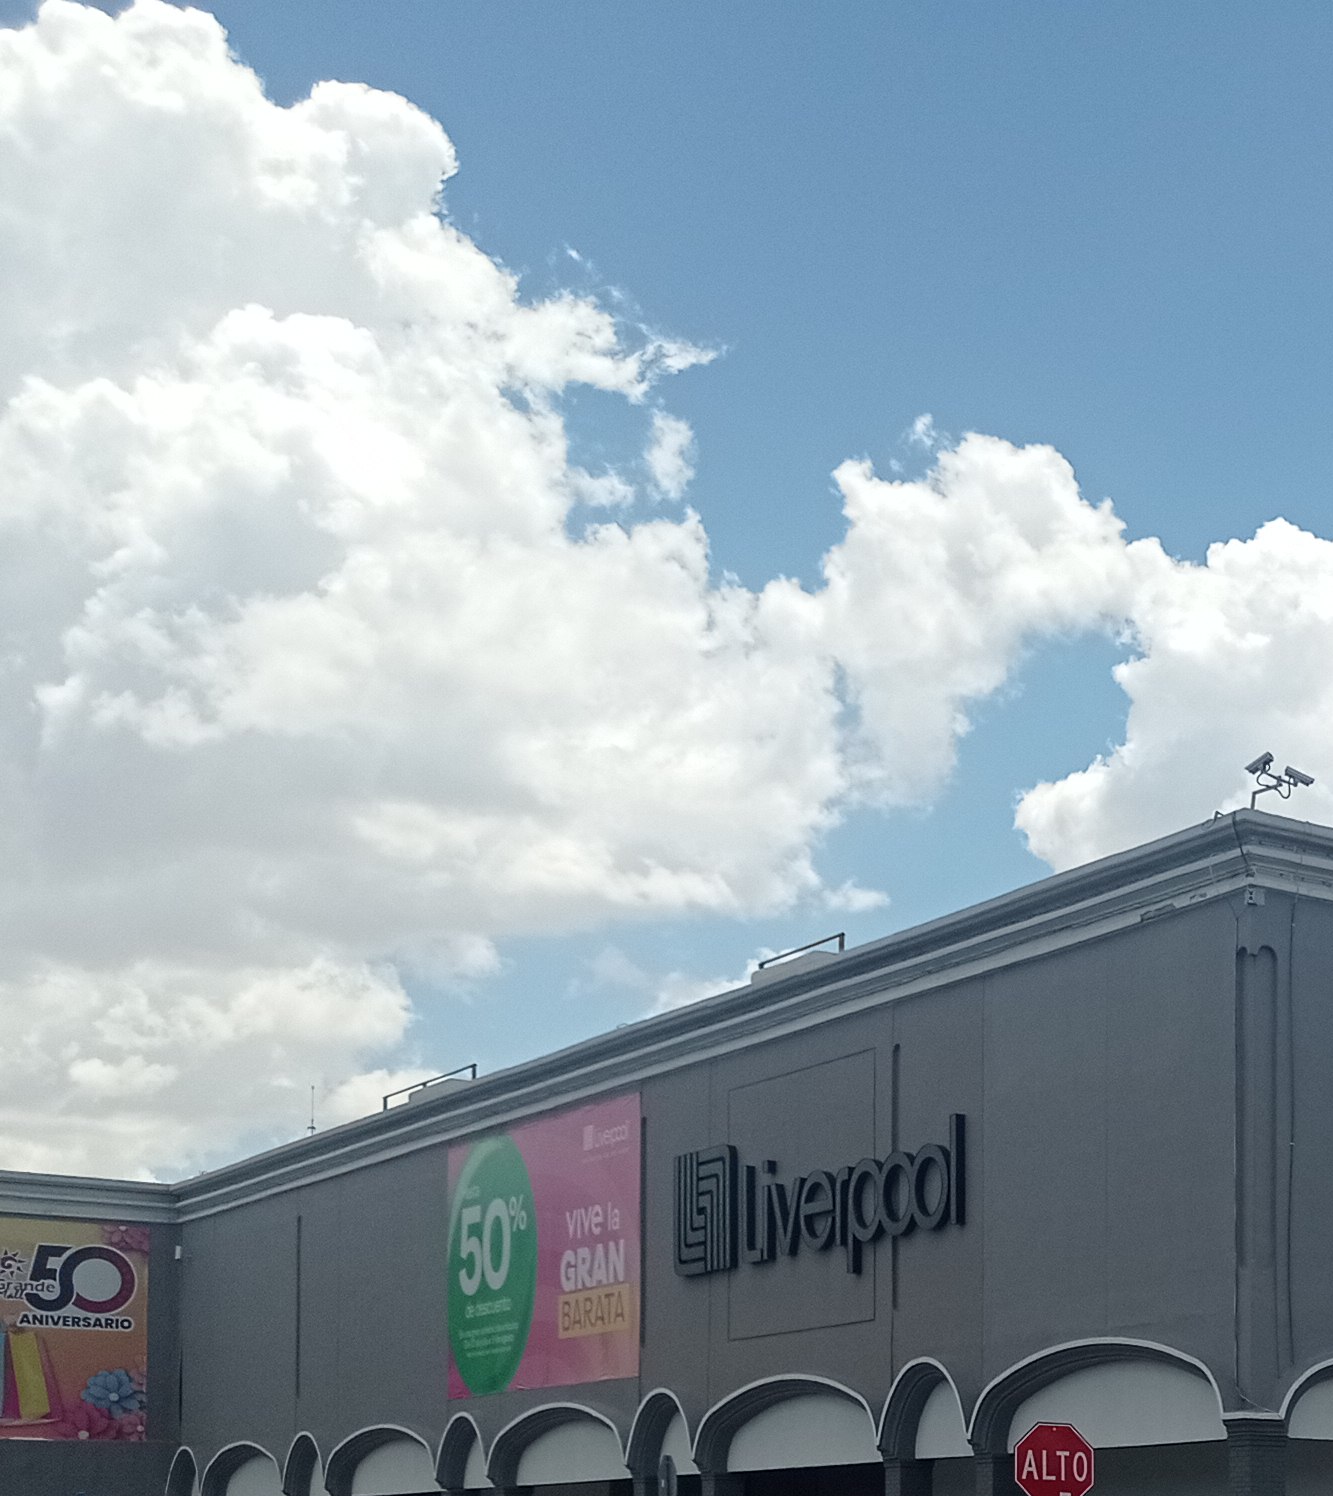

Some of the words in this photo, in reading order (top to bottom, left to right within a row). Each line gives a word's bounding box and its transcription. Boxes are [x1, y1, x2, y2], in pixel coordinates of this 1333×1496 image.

[741, 1113, 966, 1275] Liverpool
[607, 1201, 620, 1231] la
[25, 1244, 136, 1314] 50
[561, 1239, 625, 1292] GRAN
[19, 1314, 133, 1330] ANIVERSARIO
[562, 1291, 625, 1332] BARATA
[1021, 1449, 1088, 1482] ALTO
